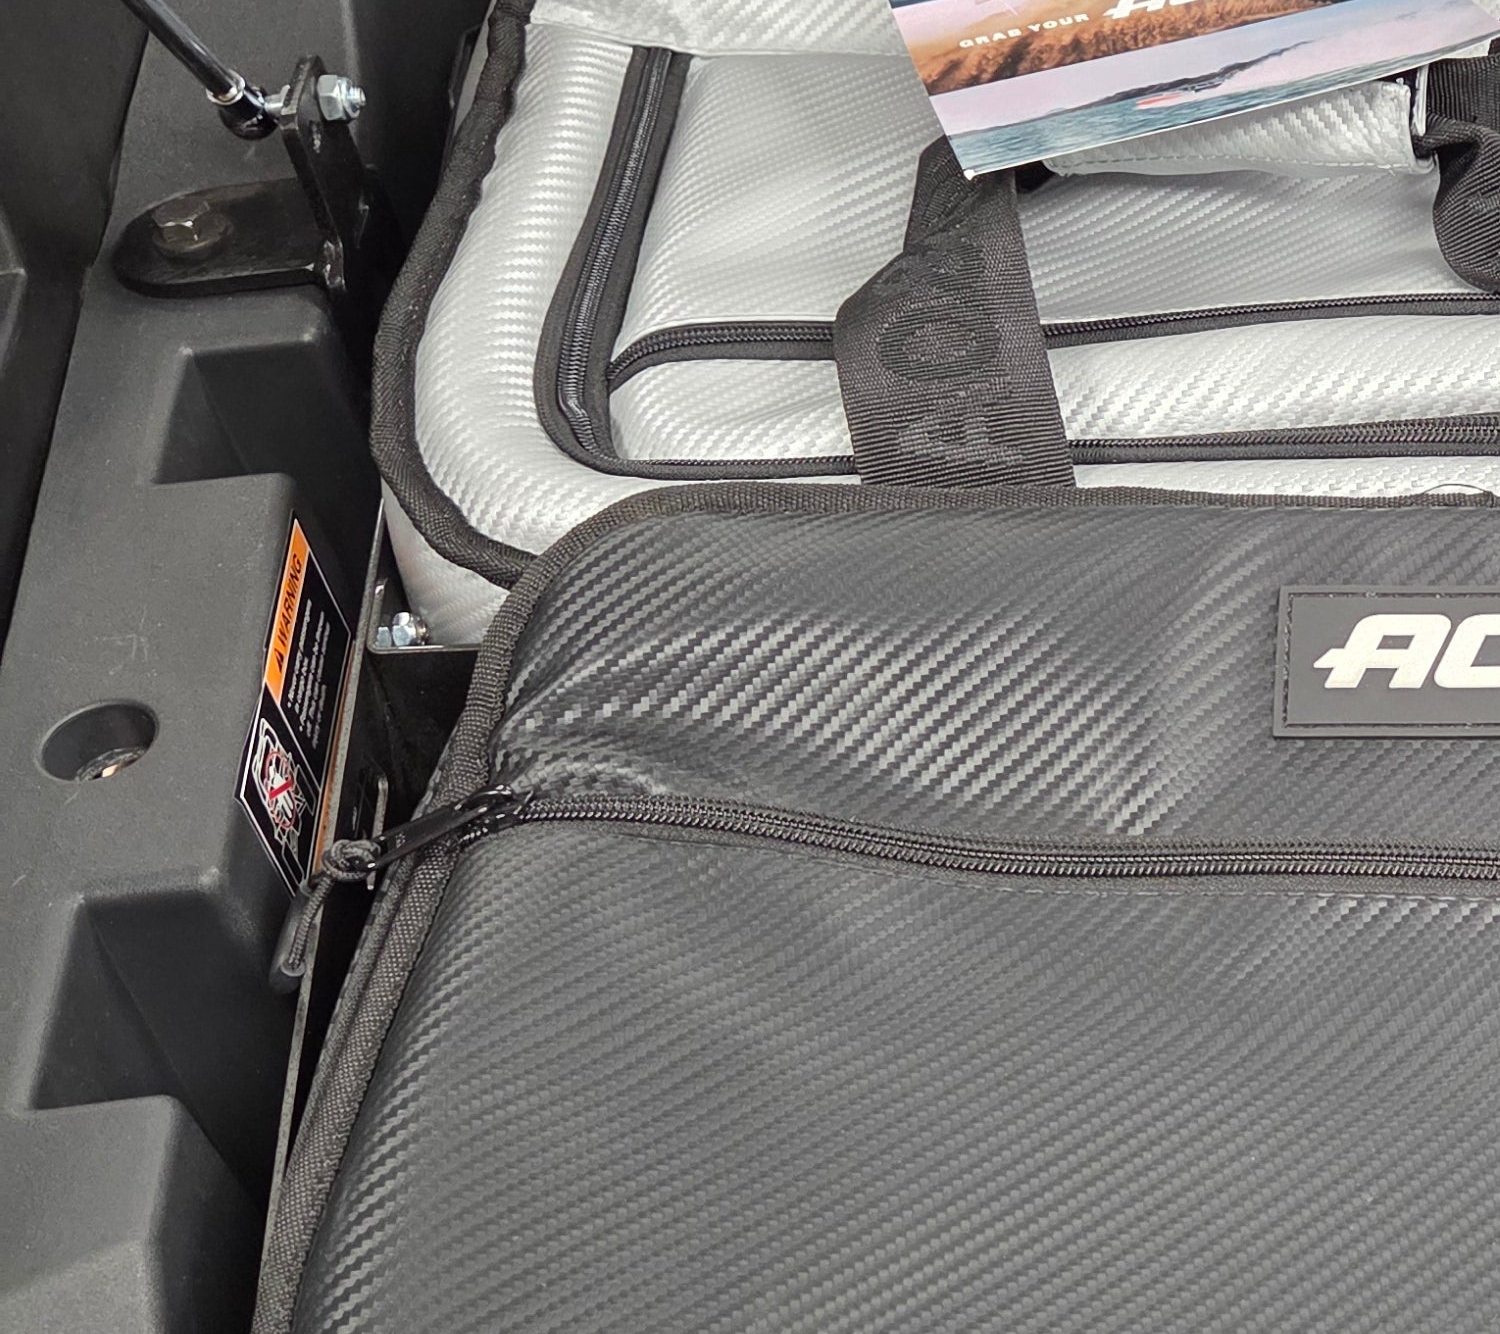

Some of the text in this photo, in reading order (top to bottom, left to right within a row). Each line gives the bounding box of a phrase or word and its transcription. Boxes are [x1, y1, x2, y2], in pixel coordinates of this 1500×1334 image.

[959, 28, 1022, 48] GRAB
[1027, 13, 1090, 32] YOUR
[277, 553, 303, 647] WARNING
